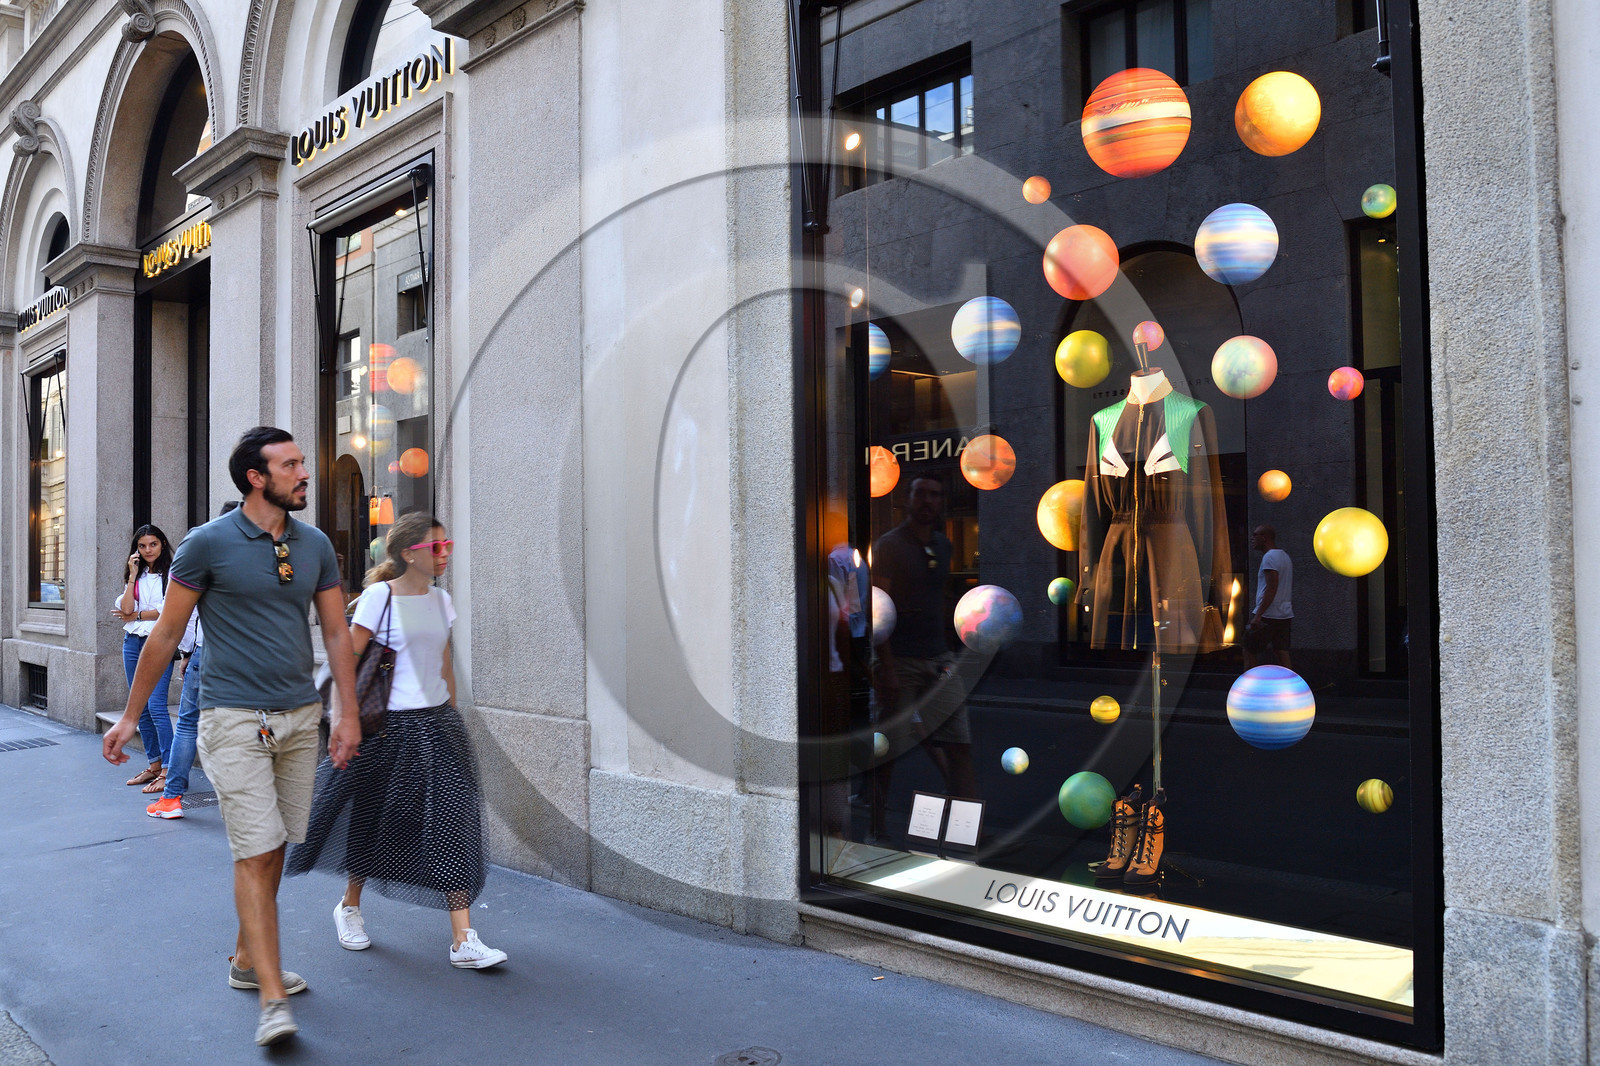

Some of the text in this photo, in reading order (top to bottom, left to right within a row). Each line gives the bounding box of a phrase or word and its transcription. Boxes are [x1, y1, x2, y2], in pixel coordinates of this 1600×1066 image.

[291, 37, 452, 166] LOUIS VUITTON
[144, 218, 212, 278] LOUIS VUITT
[17, 287, 70, 332] LOUIS VUITTON
[984, 880, 1190, 943] LOUIS VUITTON
